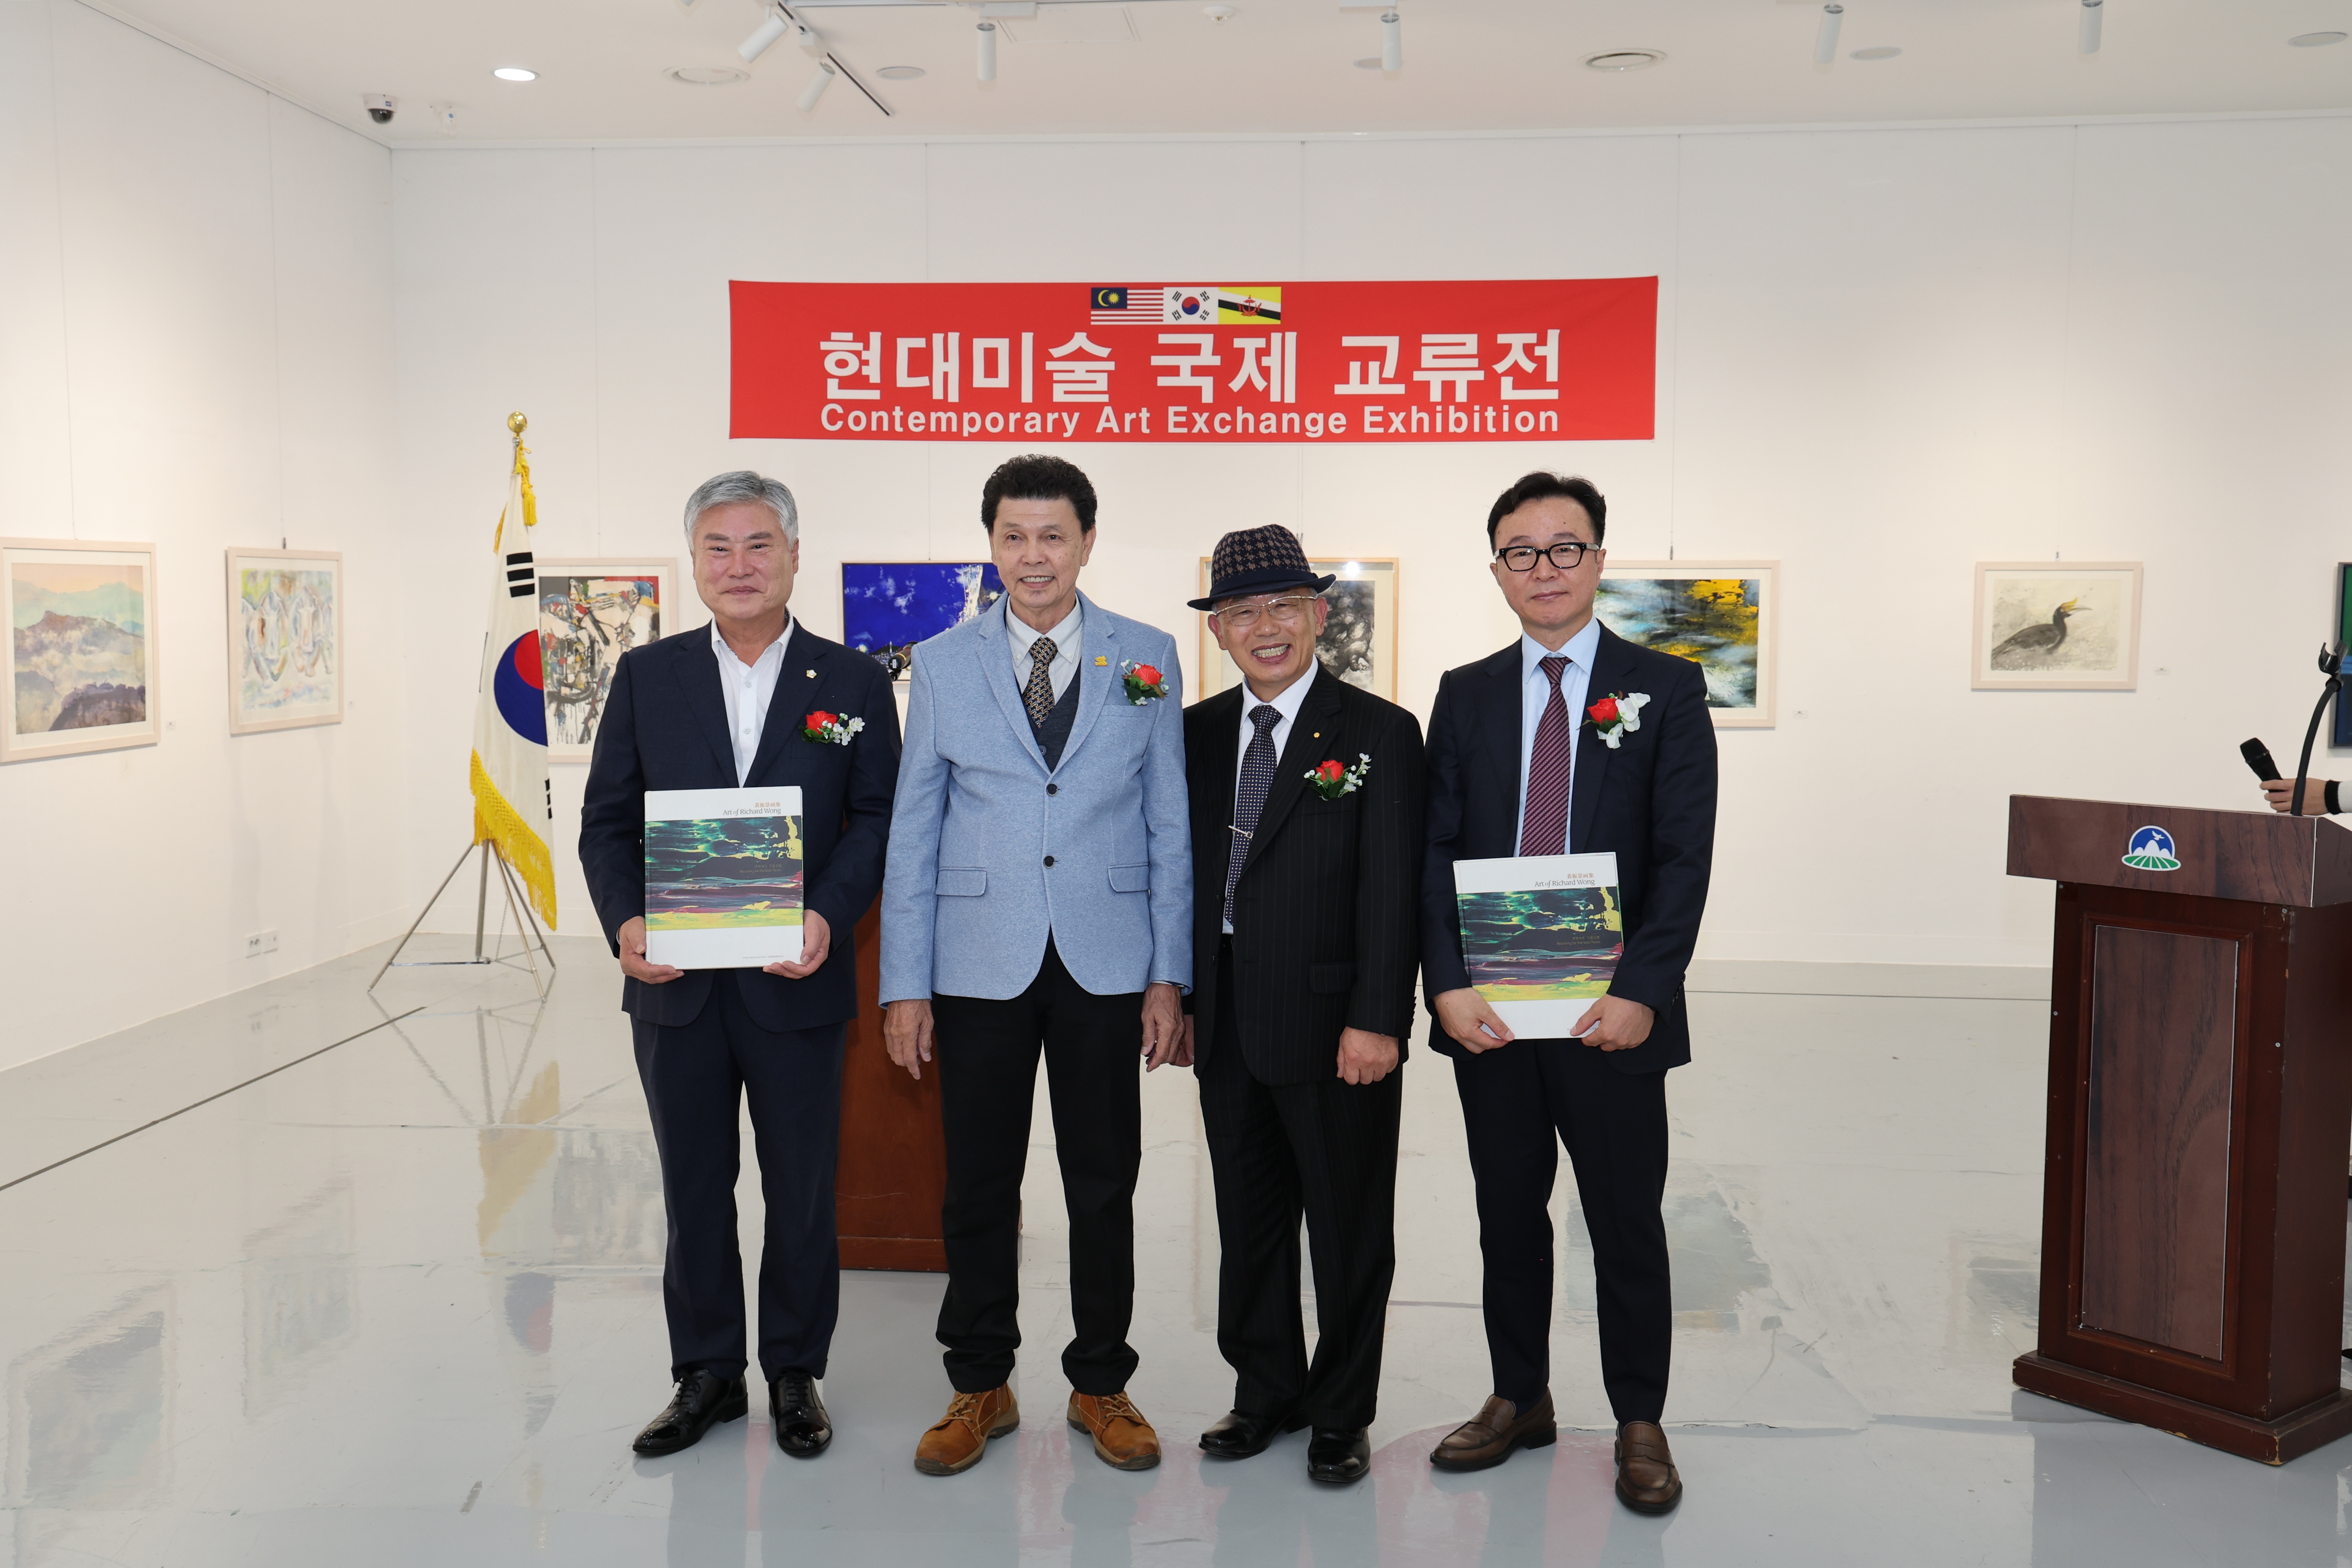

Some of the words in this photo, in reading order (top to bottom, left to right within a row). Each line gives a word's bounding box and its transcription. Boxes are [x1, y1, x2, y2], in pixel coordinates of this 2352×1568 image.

[820, 331, 1115, 403] 현대미술
[1151, 331, 1297, 403] 국제
[1334, 329, 1560, 403] 교류전
[820, 403, 1080, 438] Contemporary
[1095, 405, 1150, 434] Art
[1168, 406, 1347, 438] Exchange
[1364, 405, 1558, 434] Exhibition
[1545, 880, 1551, 888] of
